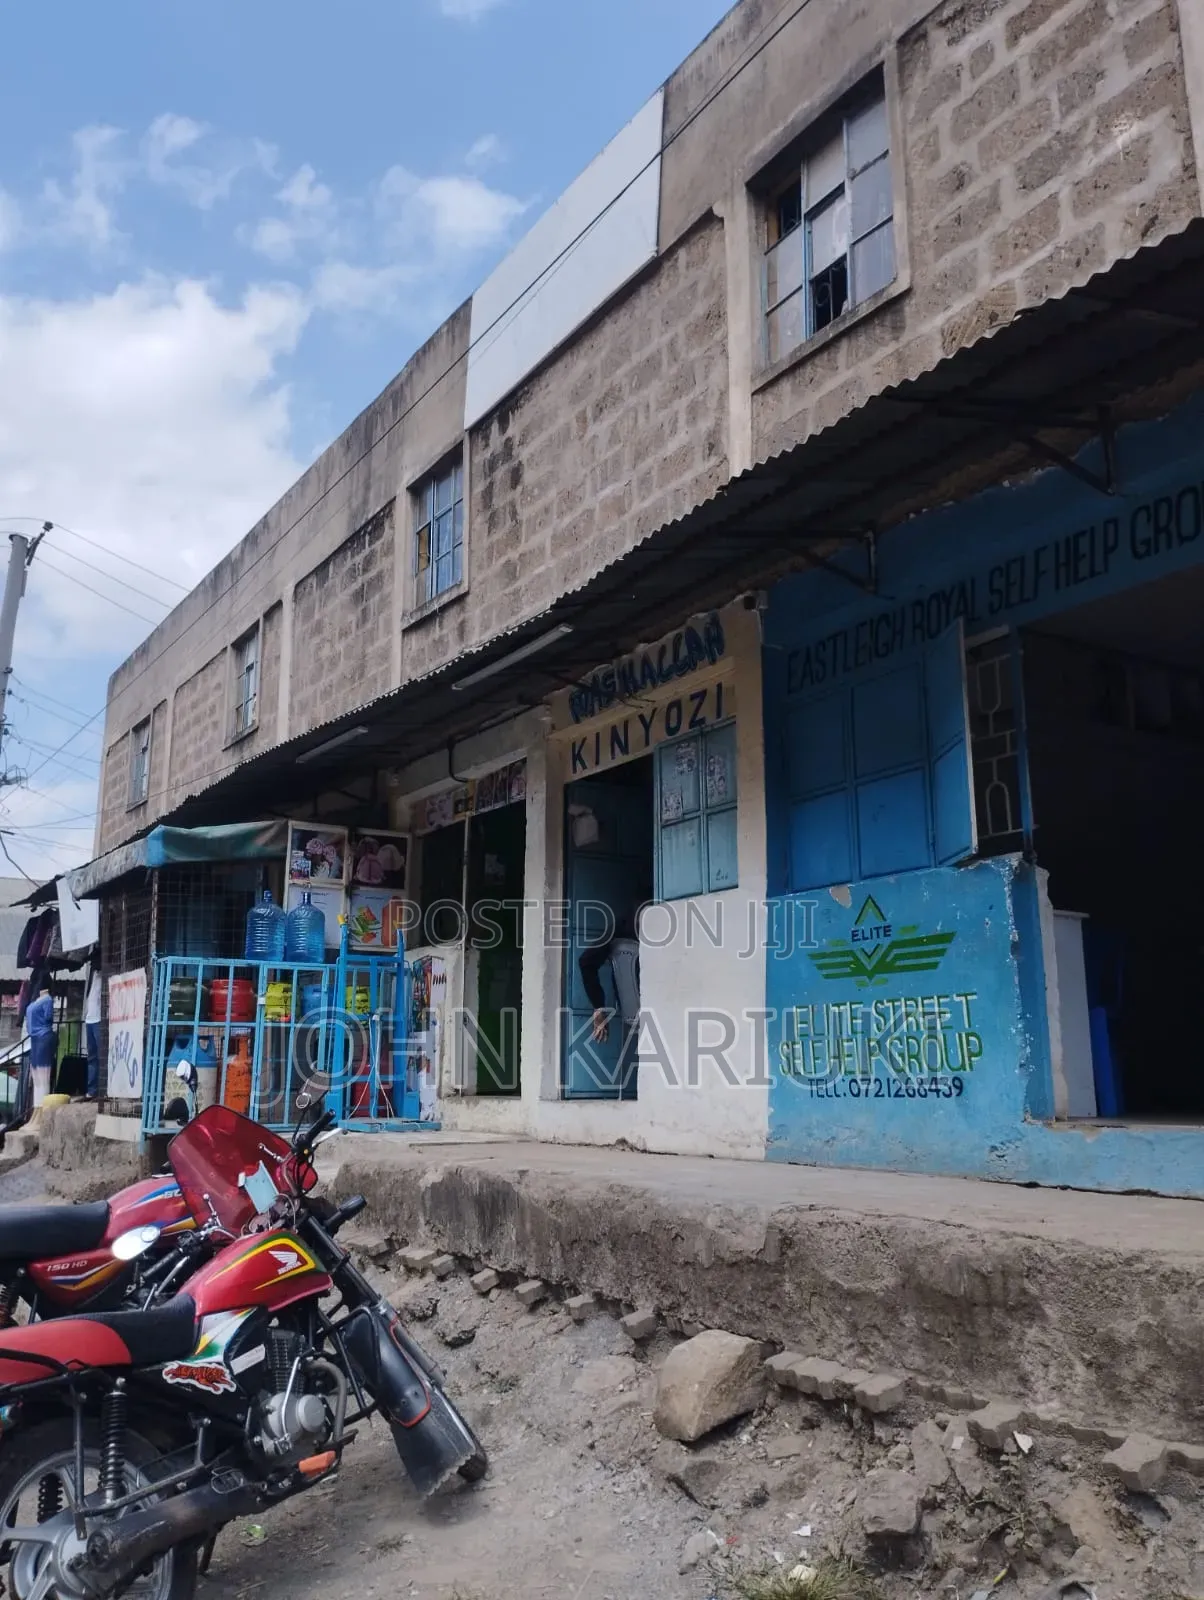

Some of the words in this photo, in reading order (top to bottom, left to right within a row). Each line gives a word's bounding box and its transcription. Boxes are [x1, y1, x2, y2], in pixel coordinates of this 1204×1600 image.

[787, 604, 906, 694] EASTLEIGH
[912, 577, 981, 644] ROYAL
[988, 545, 1048, 615] SELF
[1054, 517, 1119, 591] HELP
[1129, 481, 1204, 560] GRO
[572, 682, 723, 775] KINYOZI
[851, 925, 893, 943] ELITE
[793, 1001, 865, 1039] ELITE
[872, 991, 978, 1034] STREET
[886, 1031, 983, 1074] GROUP
